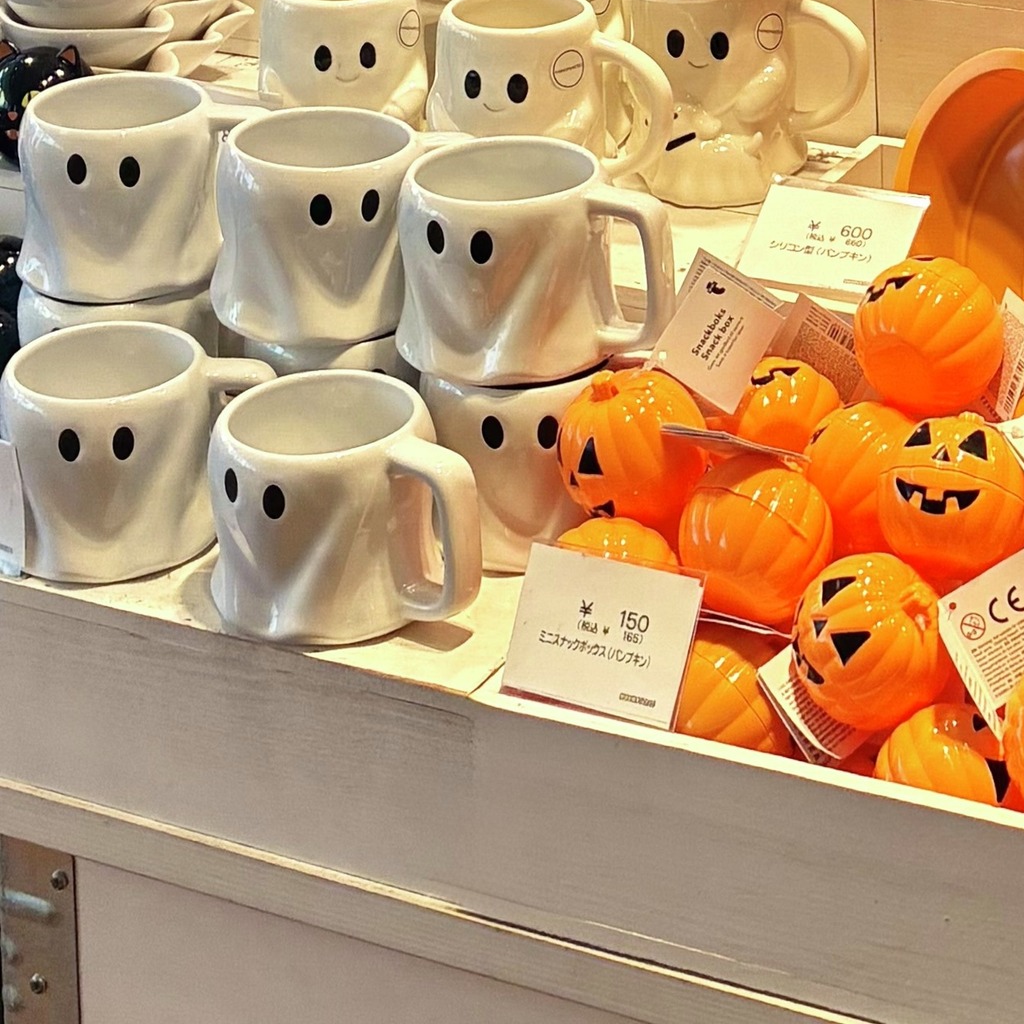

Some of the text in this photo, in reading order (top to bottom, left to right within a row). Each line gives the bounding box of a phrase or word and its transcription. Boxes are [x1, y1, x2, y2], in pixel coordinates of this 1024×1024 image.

[808, 219, 873, 241] ¥ 600
[691, 308, 727, 356] Snackboks
[701, 333, 723, 361] Snack
[718, 315, 735, 334] box
[579, 599, 650, 633] ¥ 150
